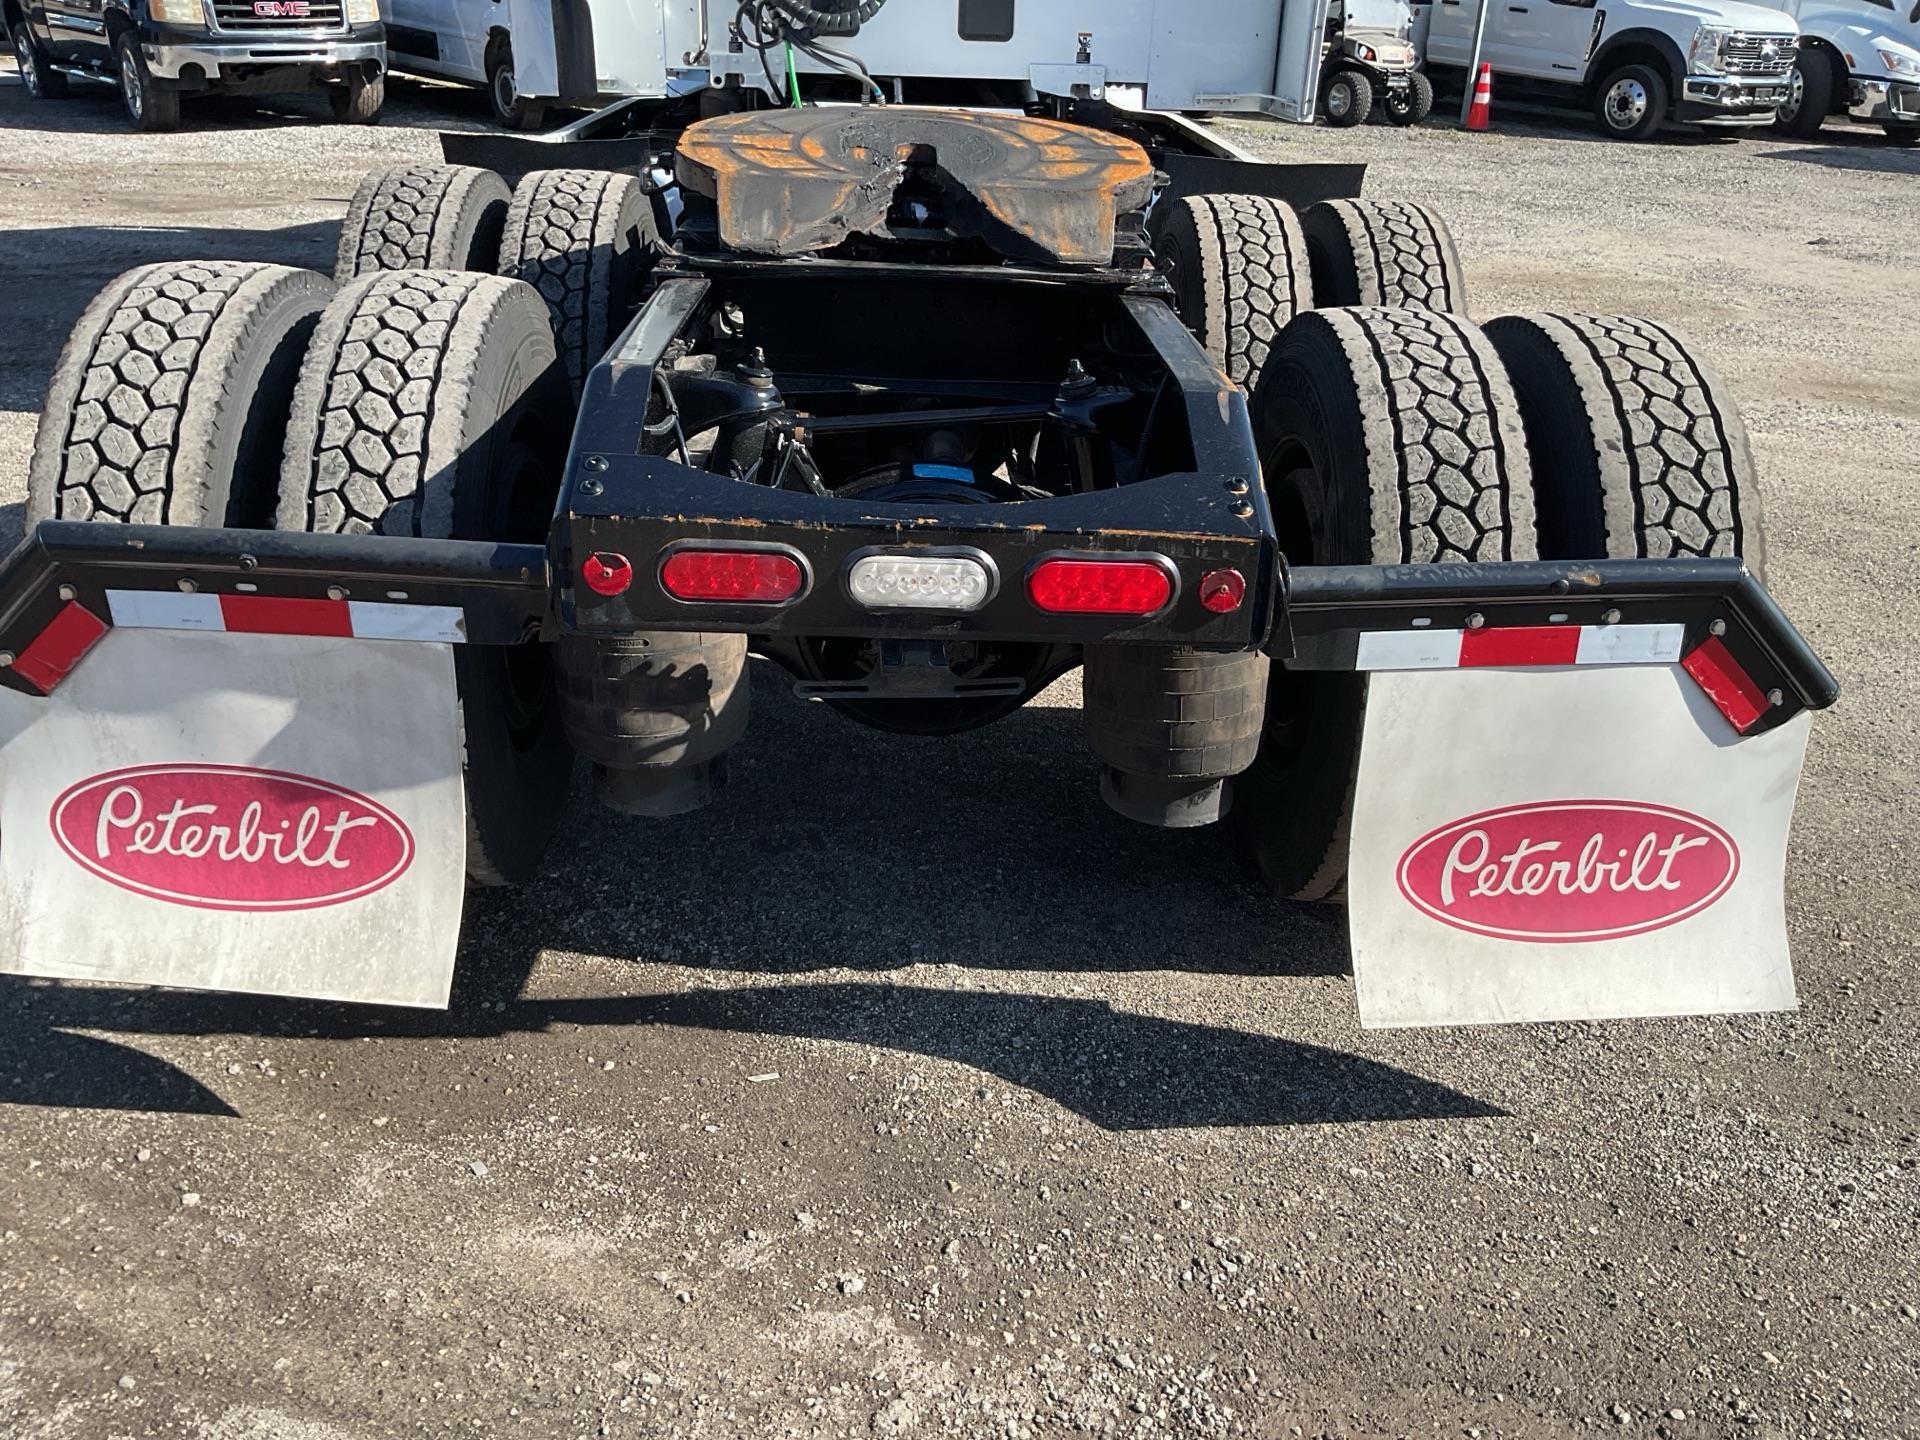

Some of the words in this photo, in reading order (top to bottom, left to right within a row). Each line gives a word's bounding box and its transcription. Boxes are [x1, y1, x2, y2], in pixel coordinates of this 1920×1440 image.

[254, 1, 310, 16] GMC
[96, 784, 378, 869] Peterbilt
[1441, 829, 1710, 907] Peterbilt
